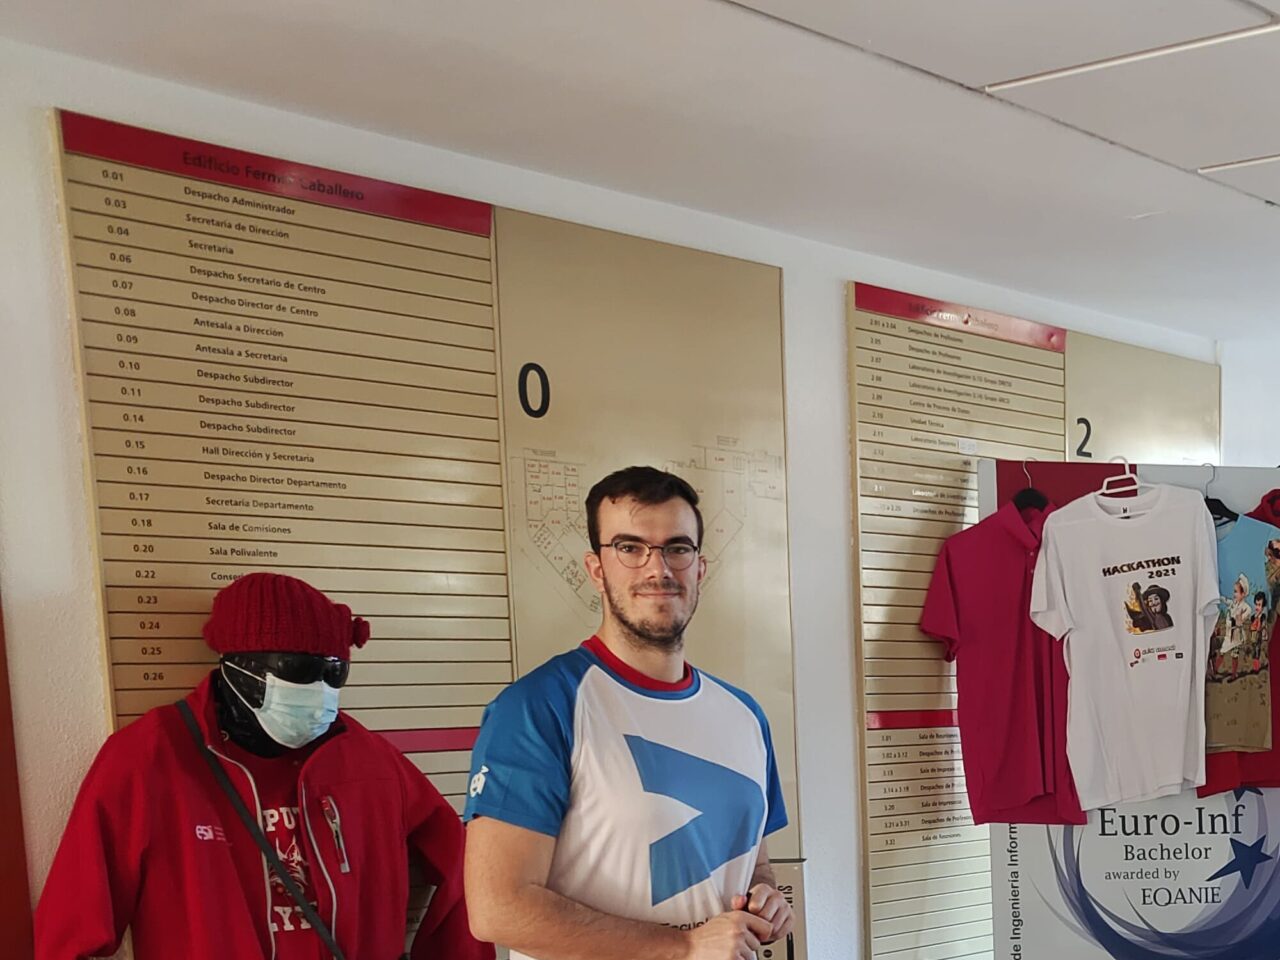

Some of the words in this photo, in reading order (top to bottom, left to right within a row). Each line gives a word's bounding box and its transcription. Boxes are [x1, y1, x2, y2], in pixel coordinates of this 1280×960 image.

[183, 152, 239, 176] Edificio
[245, 166, 295, 185] Ferm
[102, 170, 124, 182] 0.01
[104, 197, 127, 209] 0.03
[184, 186, 230, 203] Despacho
[232, 195, 296, 216] Administrador
[107, 225, 129, 237] 0.04
[235, 221, 247, 232] de
[109, 252, 132, 264] 0.06
[112, 279, 133, 291] 0.07
[190, 265, 235, 282] Despacho
[237, 272, 282, 288] Secretario
[284, 279, 295, 290] de
[297, 282, 326, 295] Centro
[191, 291, 236, 307] Despacho
[238, 297, 274, 312] Director
[276, 302, 287, 313] de
[289, 304, 318, 318] Centro
[114, 306, 136, 318] 0.08
[193, 317, 232, 331] Antesala
[116, 333, 138, 344] 0.09
[195, 344, 234, 357] Antesala
[118, 360, 140, 371] 0.10
[197, 369, 241, 383] Despacho
[243, 374, 294, 388] Subdirector
[120, 387, 141, 398] 0.11
[518, 362, 550, 418] 0
[198, 395, 243, 408] Despacho
[245, 399, 296, 413] Subdirector
[122, 413, 144, 424] 0.14
[200, 420, 244, 434] Despacho
[246, 424, 296, 437] Subdirector
[1076, 417, 1093, 458] 2
[124, 439, 145, 450] 0.15
[202, 445, 220, 456] Hall
[262, 452, 270, 461] y
[126, 465, 148, 476] 0.16
[204, 471, 247, 485] Despacho
[249, 475, 284, 486] Director
[286, 478, 347, 491] Departamento
[128, 491, 150, 502] 0.17
[252, 499, 314, 513] Departamento
[131, 518, 152, 528] 0.18
[207, 521, 226, 532] Sala
[229, 522, 240, 532] de
[242, 523, 292, 535] Comisiones
[133, 544, 154, 554] 0.20
[209, 547, 228, 557] Sala
[230, 548, 278, 559] Polivalente
[1102, 556, 1181, 577] HACKATHON
[135, 569, 156, 580] 0.22
[1147, 568, 1177, 578] 2021
[137, 595, 158, 605] 0.23
[139, 621, 160, 631] 0.24
[141, 646, 162, 656] 0.25
[143, 672, 164, 682] 0.26
[1098, 804, 1246, 836] Euro-Inf
[1124, 843, 1212, 860] Bachelor
[1104, 868, 1159, 880] awarded
[1164, 868, 1180, 881] by
[1141, 887, 1222, 906] EQANIE
[1007, 871, 1023, 939] Ingeniería
[1010, 944, 1022, 960] de
